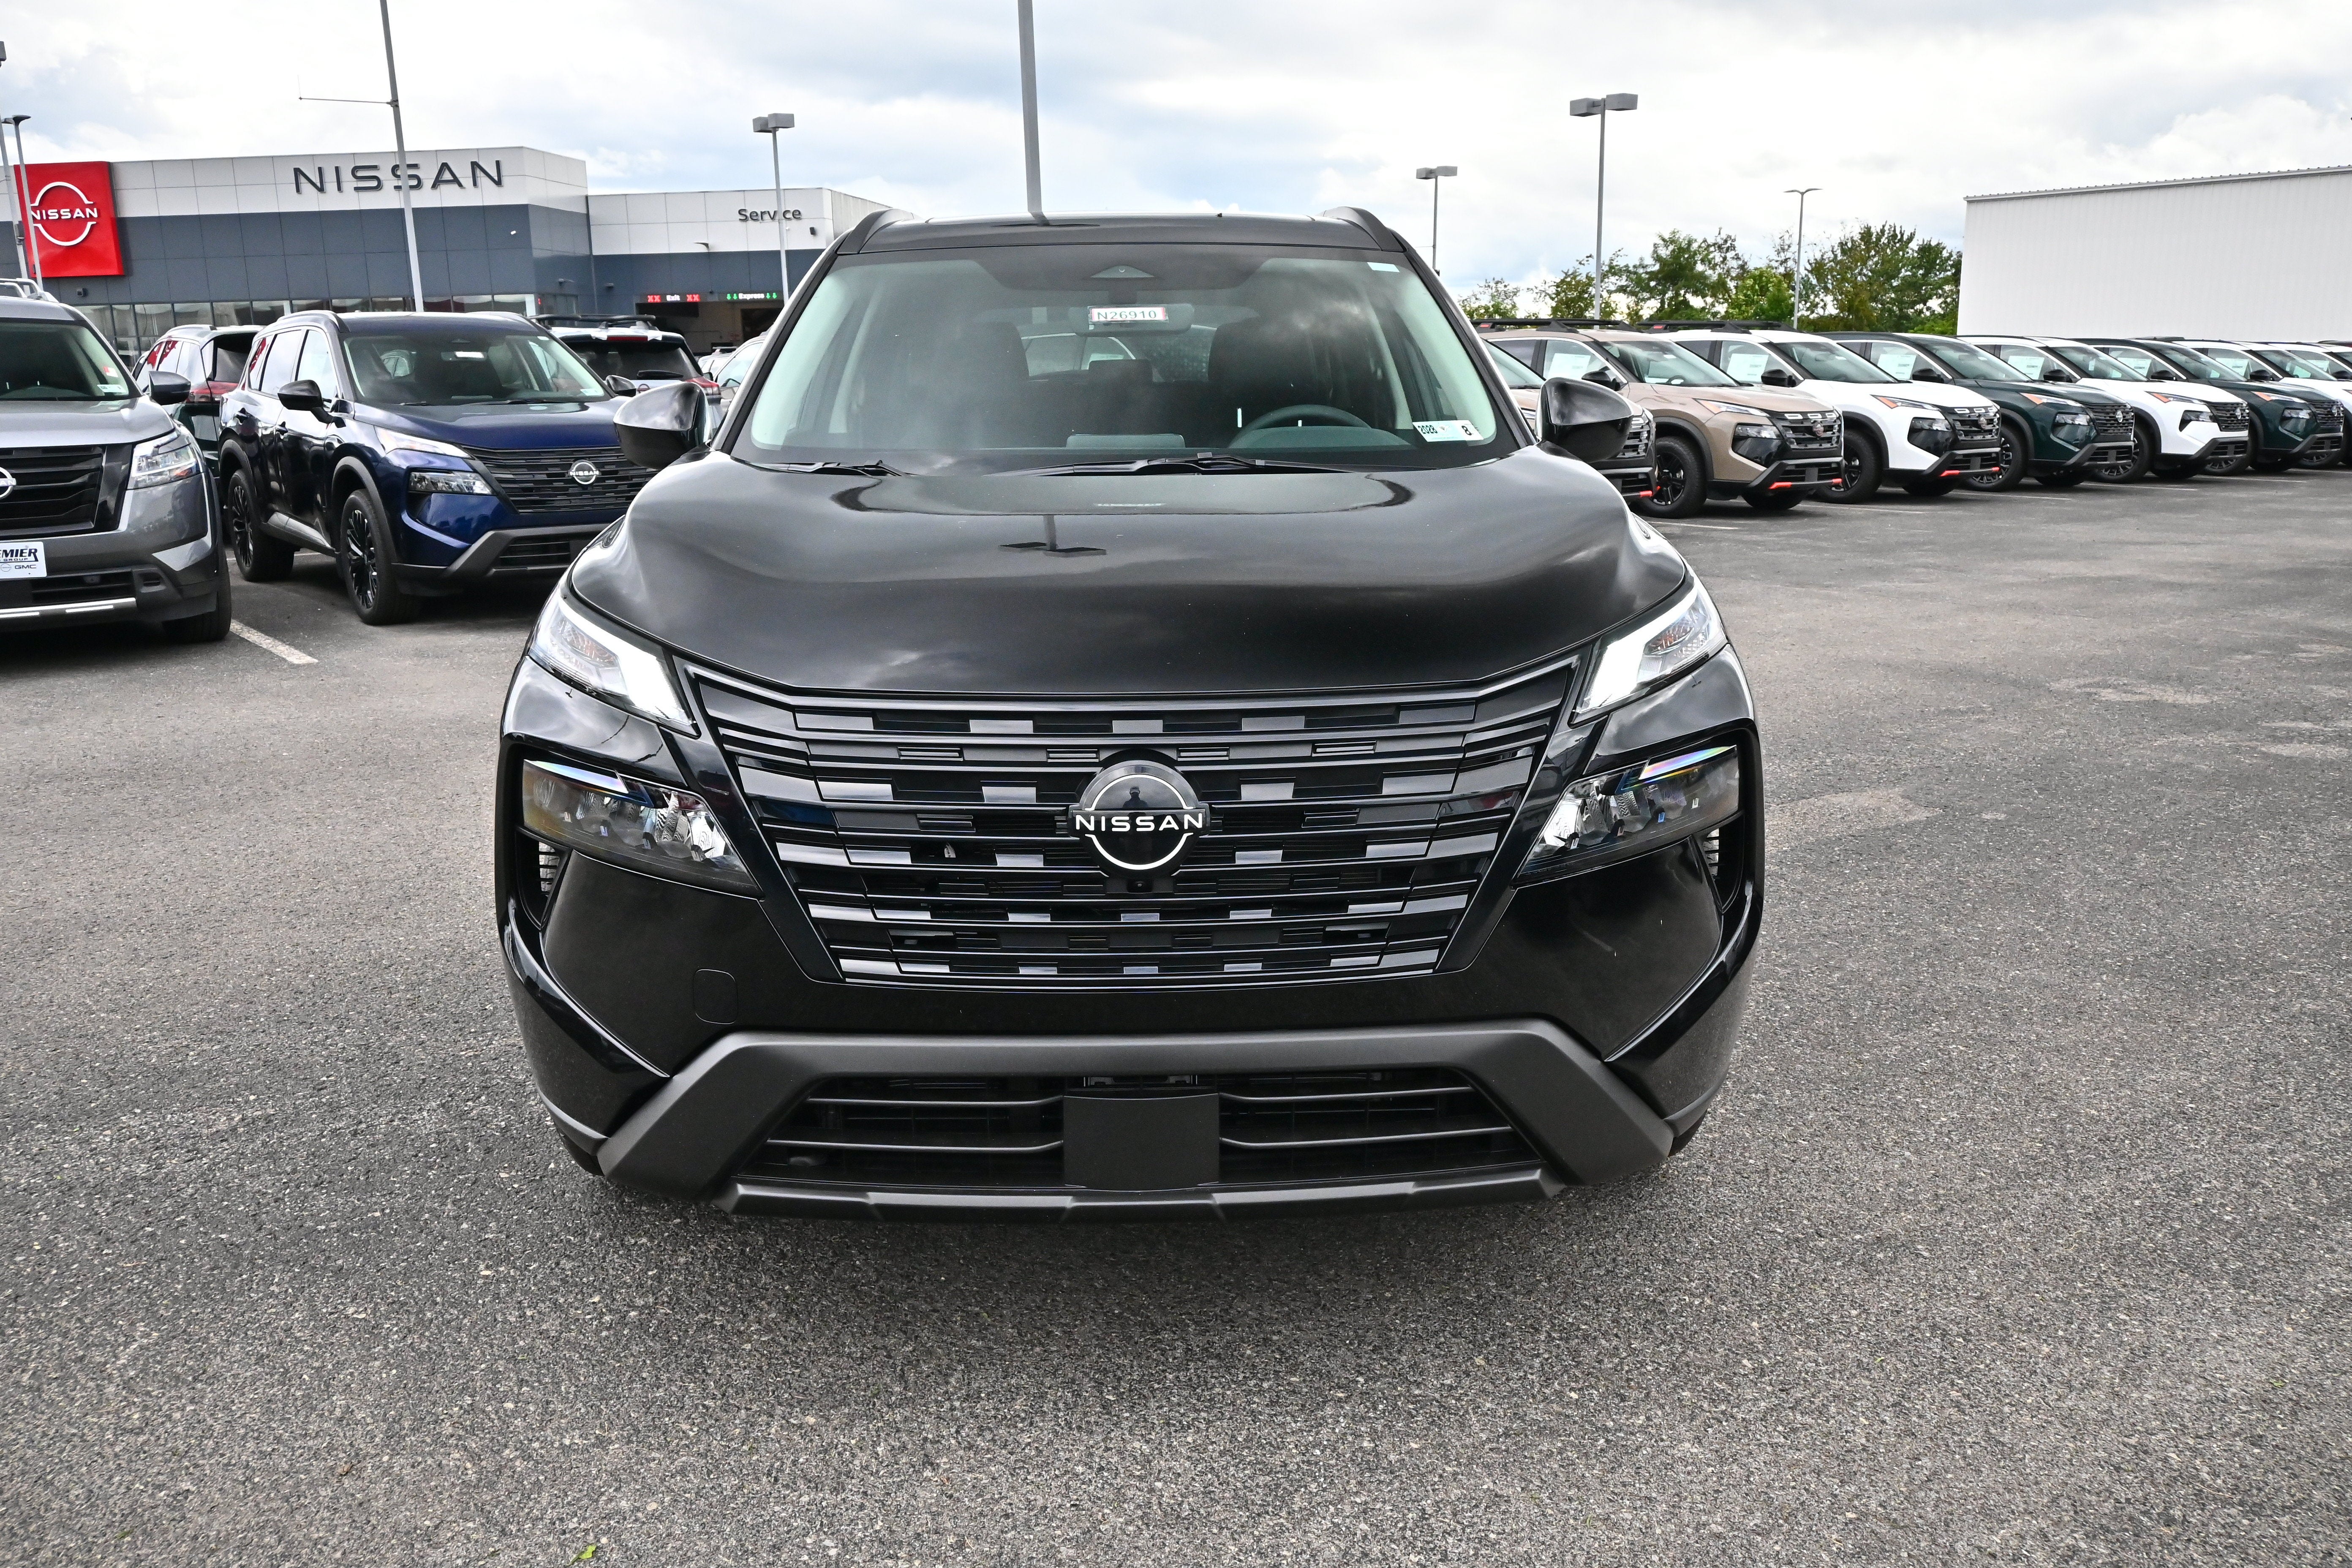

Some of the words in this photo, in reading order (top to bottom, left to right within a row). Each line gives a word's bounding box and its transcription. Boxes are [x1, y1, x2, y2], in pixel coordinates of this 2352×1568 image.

[293, 160, 503, 193] NISSAN
[31, 207, 98, 220] NISSAN
[738, 209, 802, 221] Servce
[1097, 310, 1157, 320] N26910
[1417, 425, 1438, 434] 2028
[1461, 425, 1472, 436] 8
[0, 548, 38, 561] MIER
[1075, 813, 1203, 832] NISSAN
